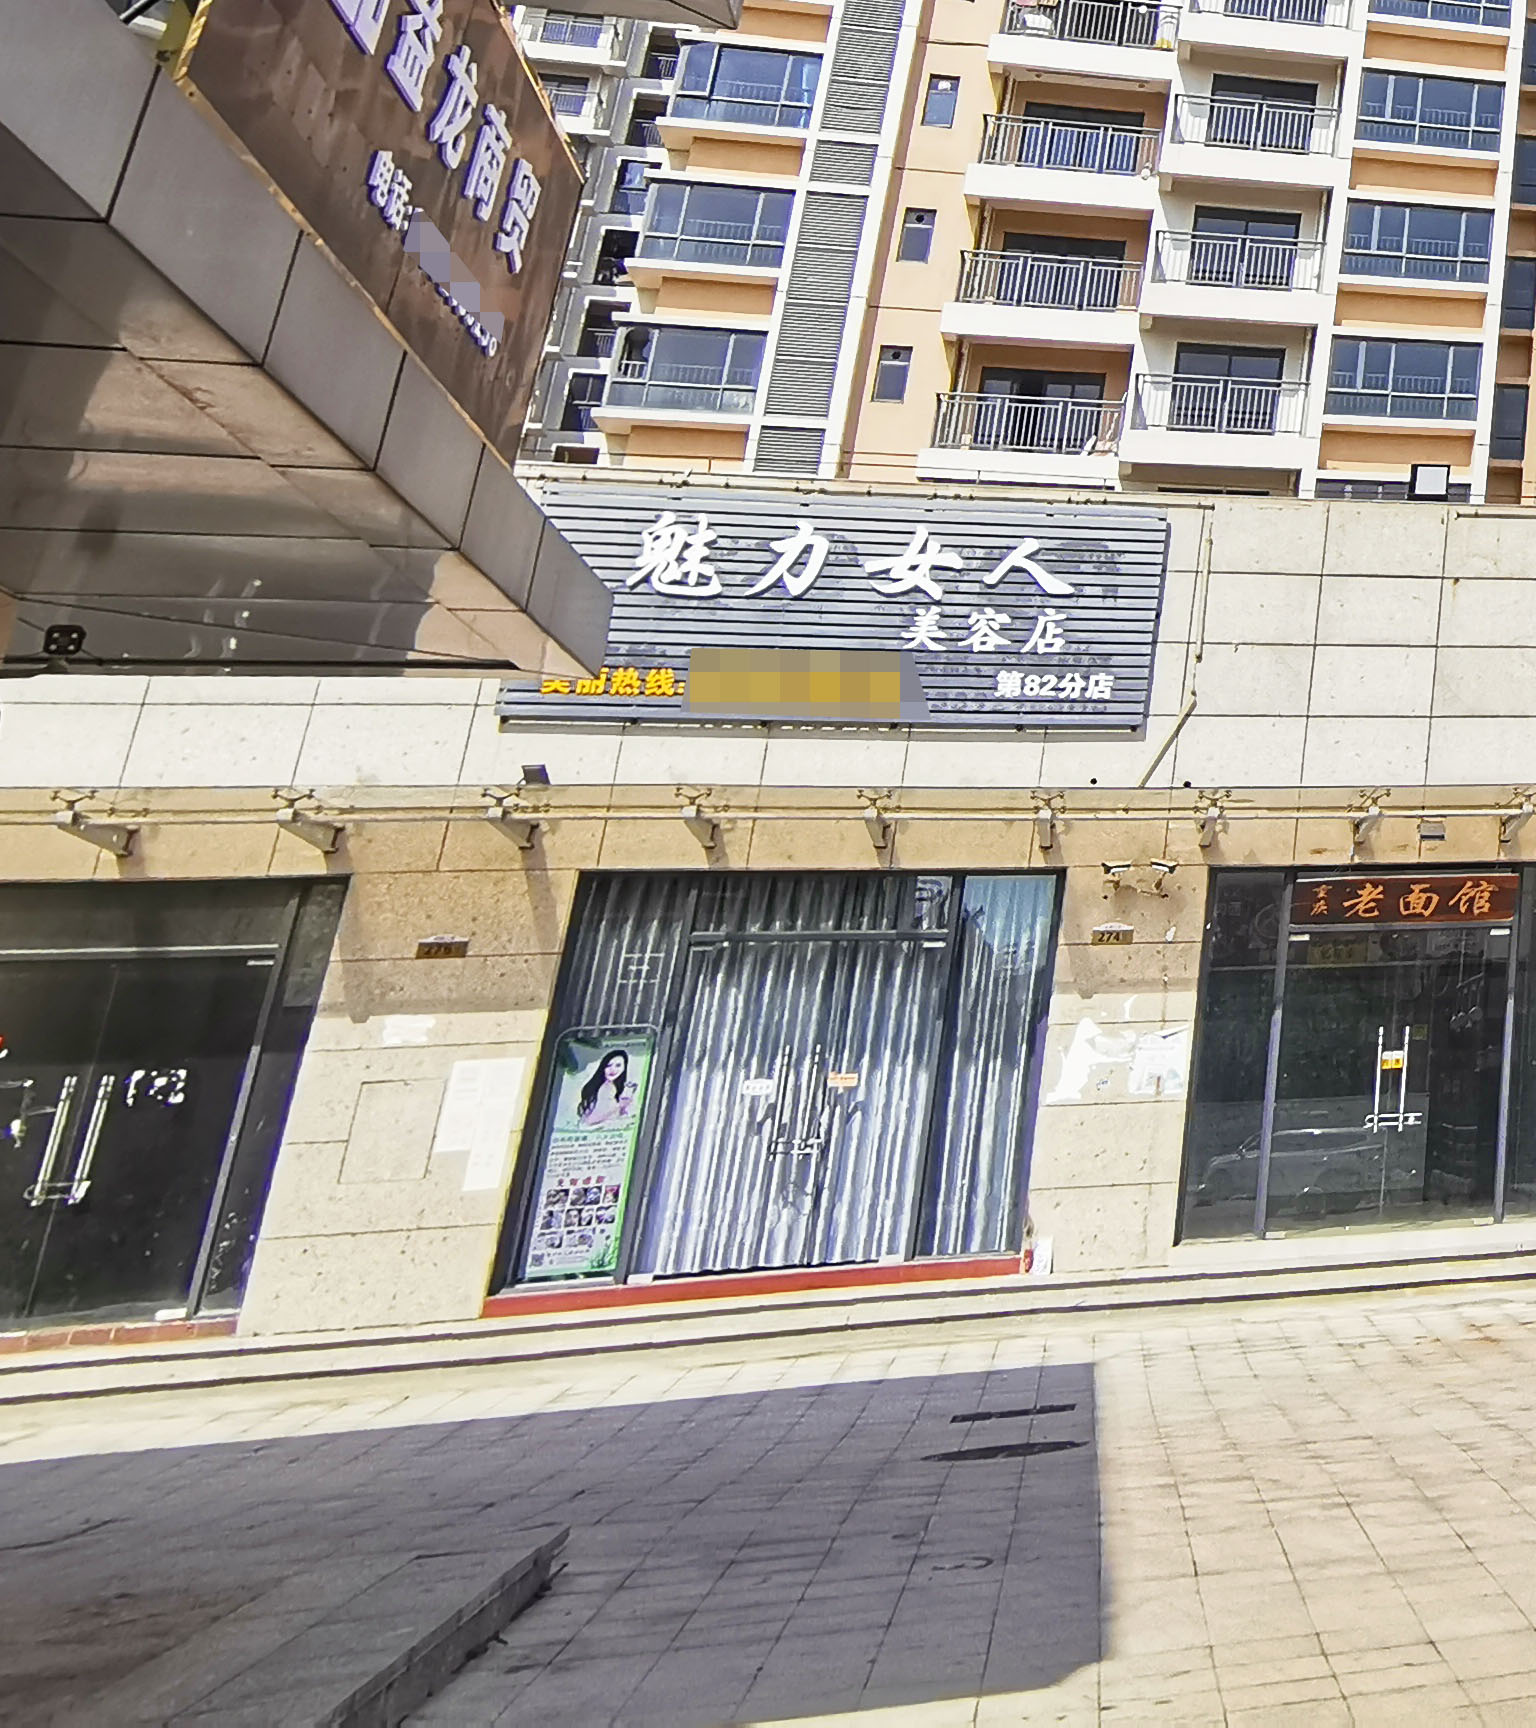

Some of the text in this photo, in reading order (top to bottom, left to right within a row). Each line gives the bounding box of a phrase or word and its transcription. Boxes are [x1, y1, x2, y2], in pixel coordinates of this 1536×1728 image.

[623, 512, 1076, 601] 魅力女人
[898, 606, 1069, 655] 美容店
[993, 667, 1116, 702] 第82分店
[1342, 879, 1500, 919] 老面馆
